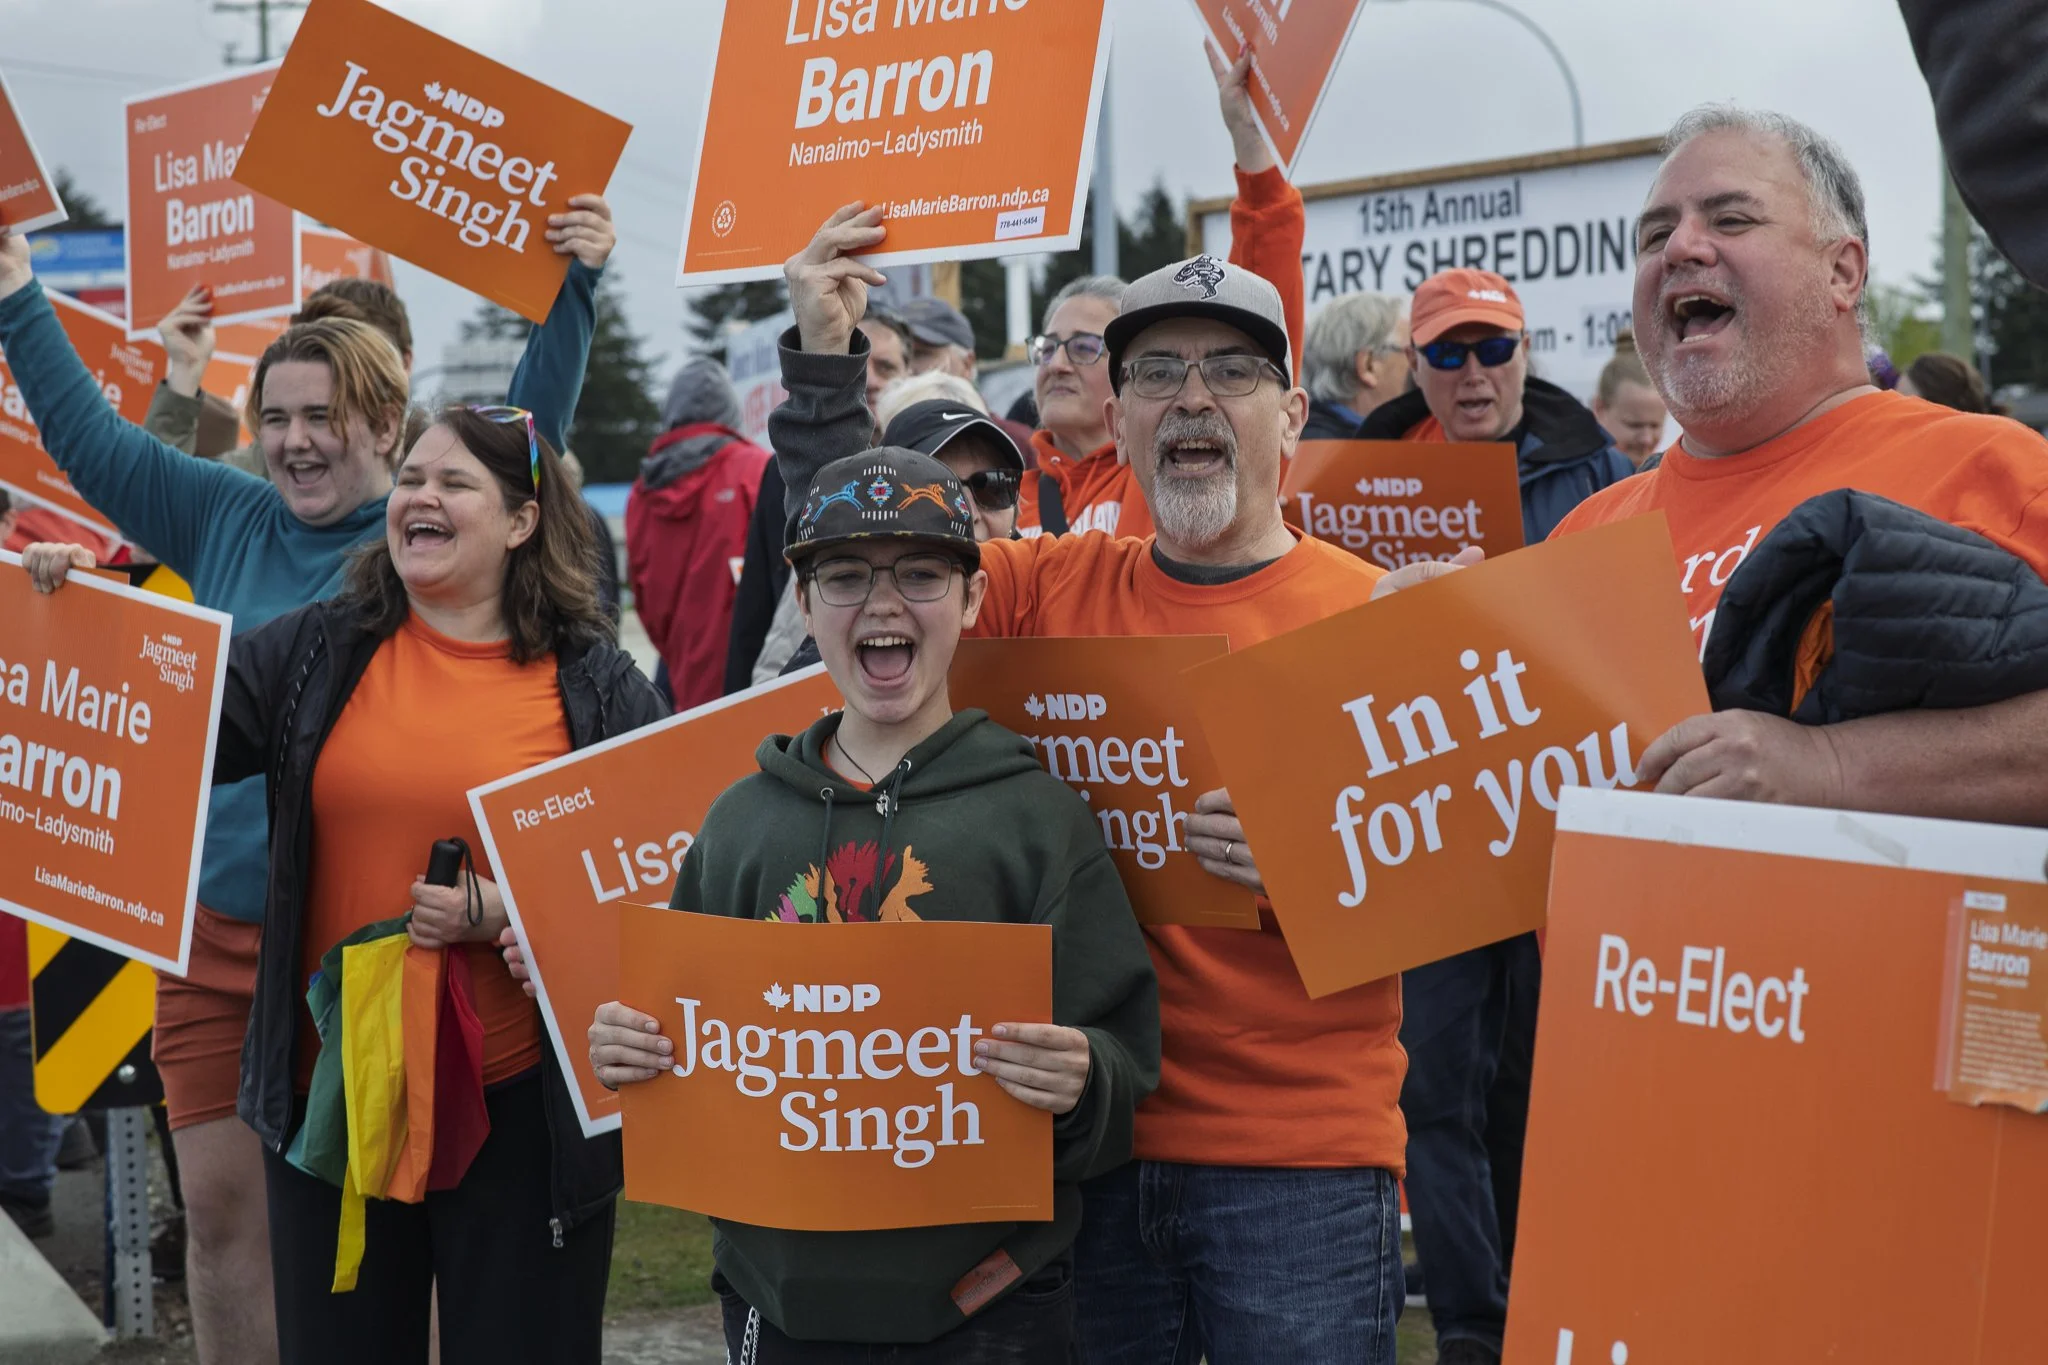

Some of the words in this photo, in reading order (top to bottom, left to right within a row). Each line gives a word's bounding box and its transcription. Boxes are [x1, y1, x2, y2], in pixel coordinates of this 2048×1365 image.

[440, 88, 505, 128] NDP
[794, 49, 993, 129] Barron
[317, 60, 558, 207] Jagmeet
[154, 150, 198, 193] Lisa
[166, 194, 255, 247] Barron
[389, 156, 531, 254] Singh
[882, 186, 1050, 220] LisaMarieBarron.ndp.ca
[1359, 195, 1414, 235] 15th
[1422, 178, 1522, 228] Annual
[1404, 217, 1641, 295] SHREDDIN
[1373, 477, 1423, 497] NDP
[1296, 492, 1485, 549] Jagmeet
[139, 635, 198, 671] Jagmeet
[159, 663, 194, 693] Singh
[40, 659, 151, 744] Marie
[1045, 694, 1107, 721] NDP
[1342, 694, 1459, 779] In
[1459, 649, 1541, 739] it
[1020, 726, 1189, 788] meet
[512, 786, 595, 832] Re-Elect
[1081, 789, 1189, 870] ngh
[1331, 784, 1452, 908] for
[1474, 721, 1639, 857] you
[34, 866, 164, 927] LisaMarieBarron.ndp.ca
[581, 830, 695, 904] Lisa
[1967, 943, 2030, 977] Barron
[1970, 919, 2000, 945] Lisa
[793, 984, 881, 1012] NDP
[1594, 933, 1810, 1044] Re-Elect
[672, 997, 984, 1098] Jagmeet
[780, 1082, 985, 1169] Singh
